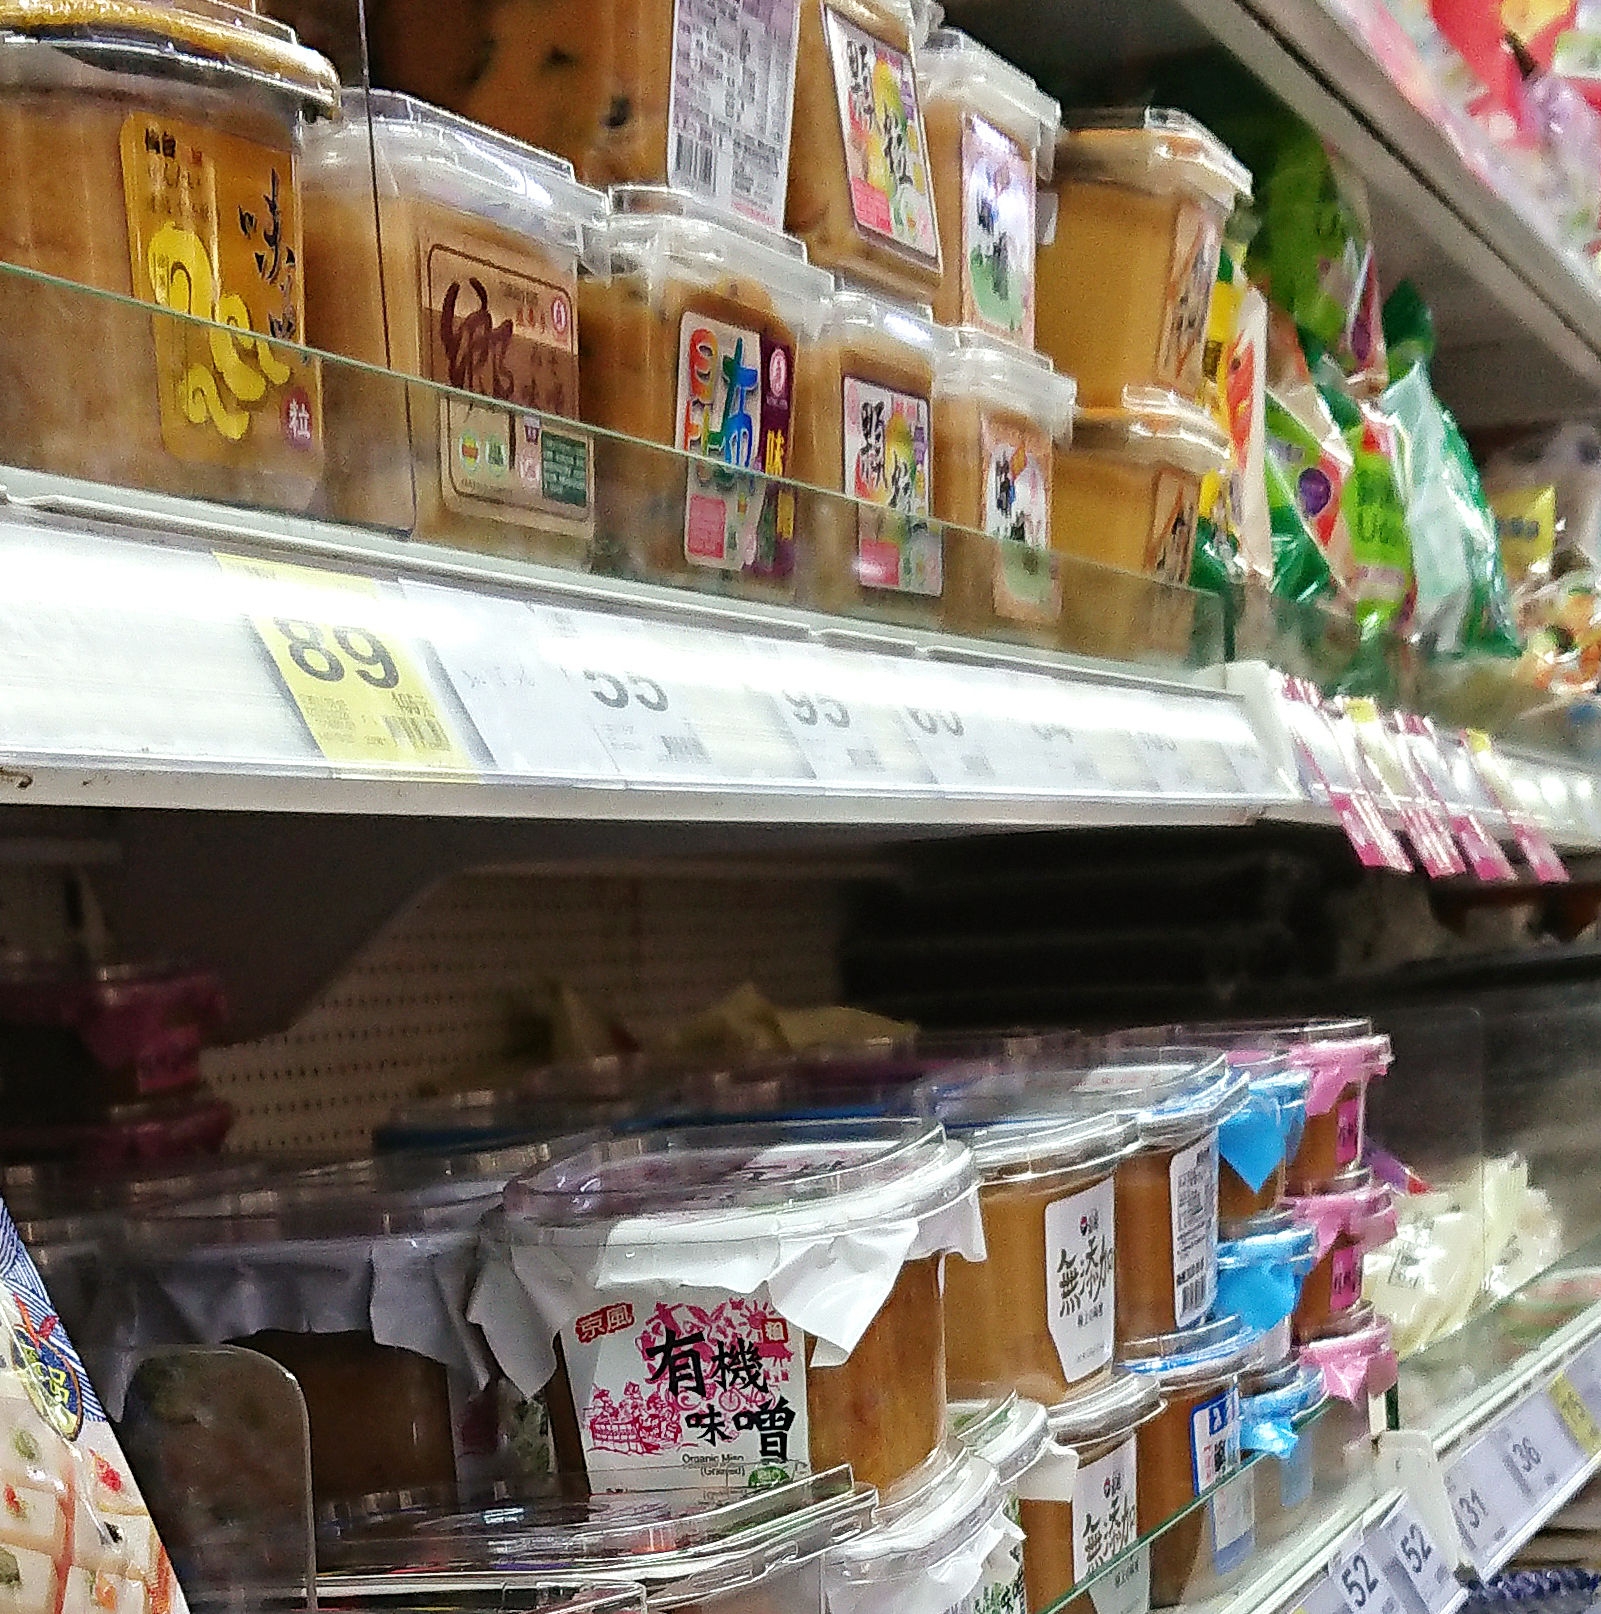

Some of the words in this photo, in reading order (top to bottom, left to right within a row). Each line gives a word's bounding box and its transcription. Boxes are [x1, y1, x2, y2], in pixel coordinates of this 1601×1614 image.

[647, 1328, 770, 1399] 有機
[685, 1395, 796, 1462] 味噌
[1401, 1524, 1433, 1575] 52
[1340, 1555, 1373, 1609] 52
